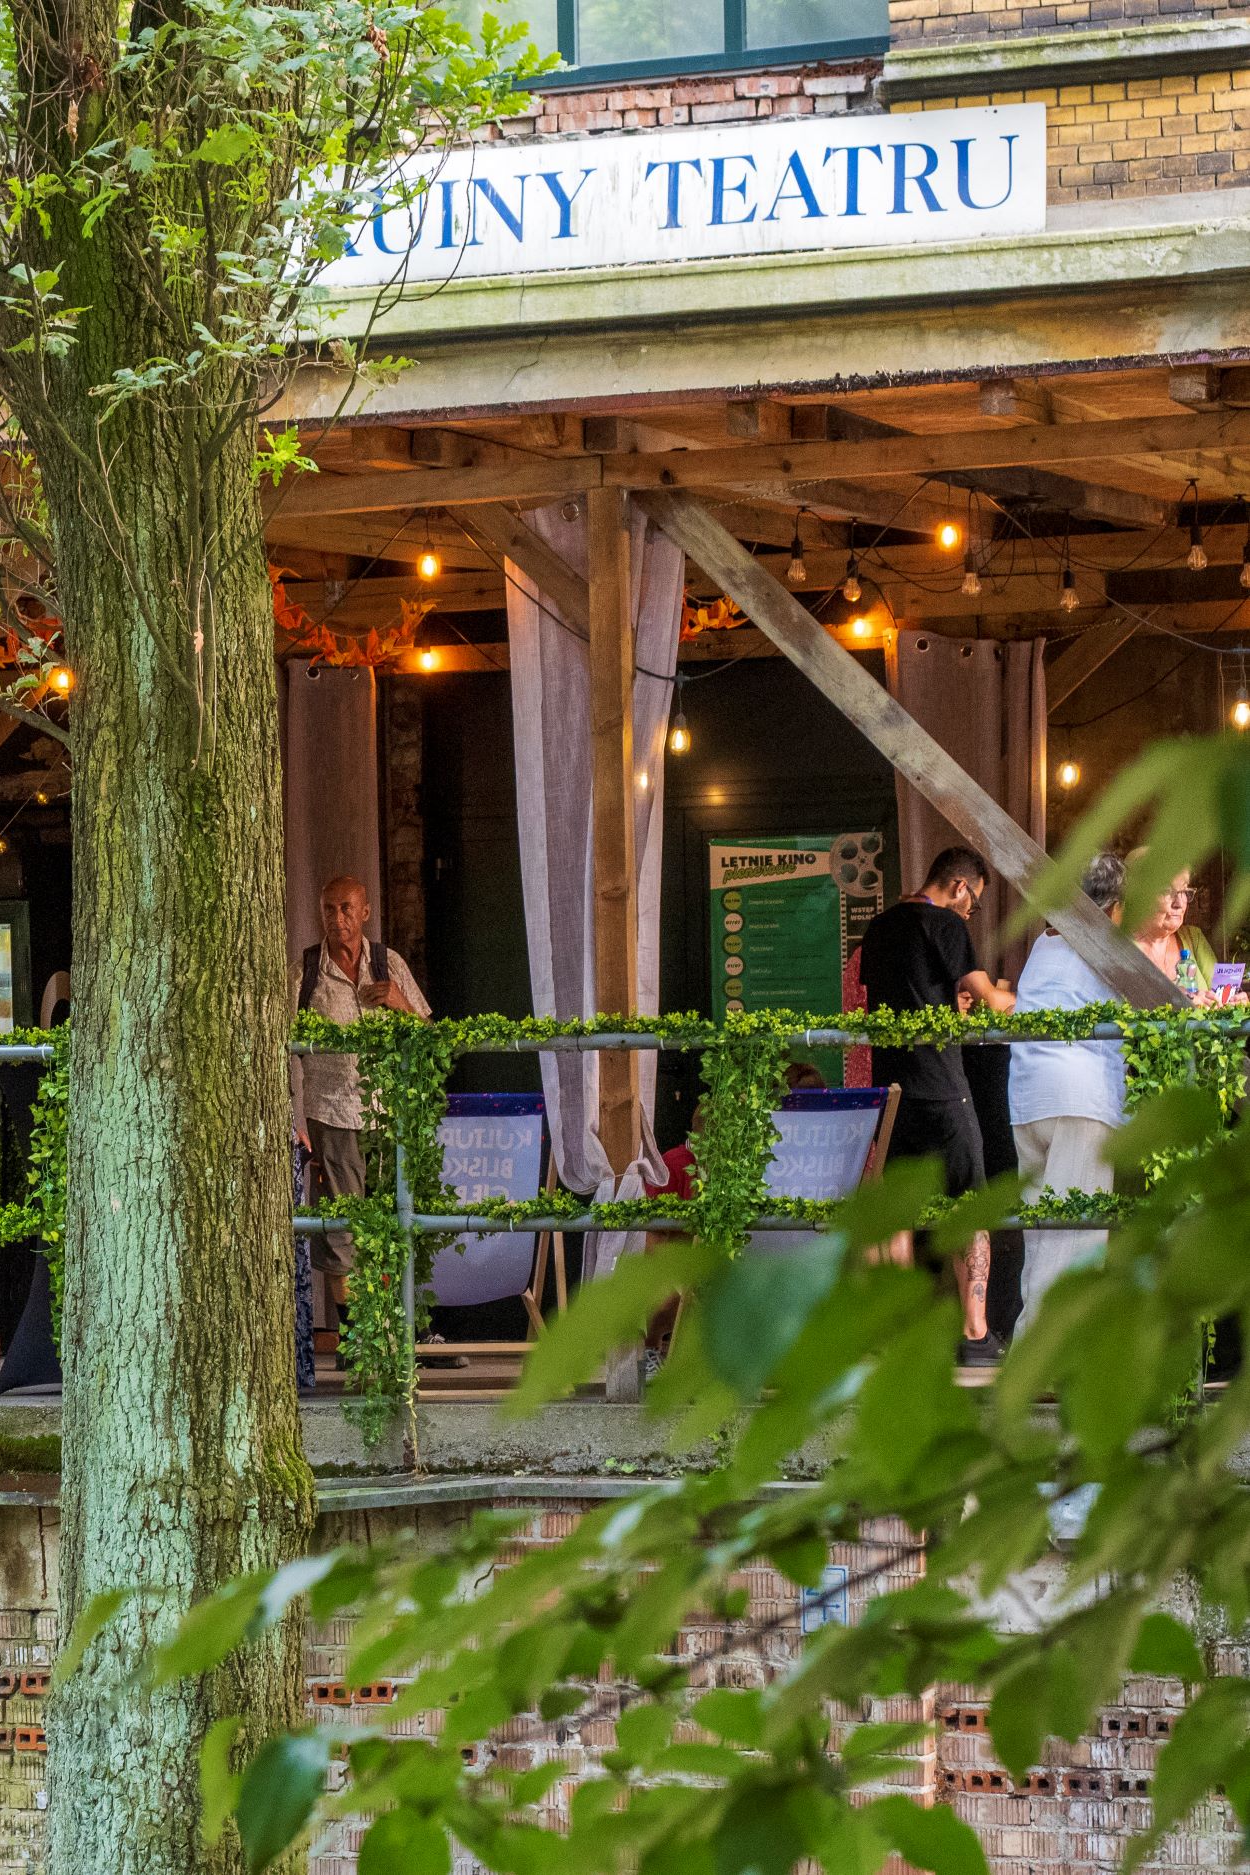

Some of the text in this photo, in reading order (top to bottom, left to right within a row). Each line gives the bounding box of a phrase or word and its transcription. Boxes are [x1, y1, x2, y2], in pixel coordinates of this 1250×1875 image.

[644, 133, 1020, 230] TEATRU
[720, 853, 817, 868] LETNIE KINO
